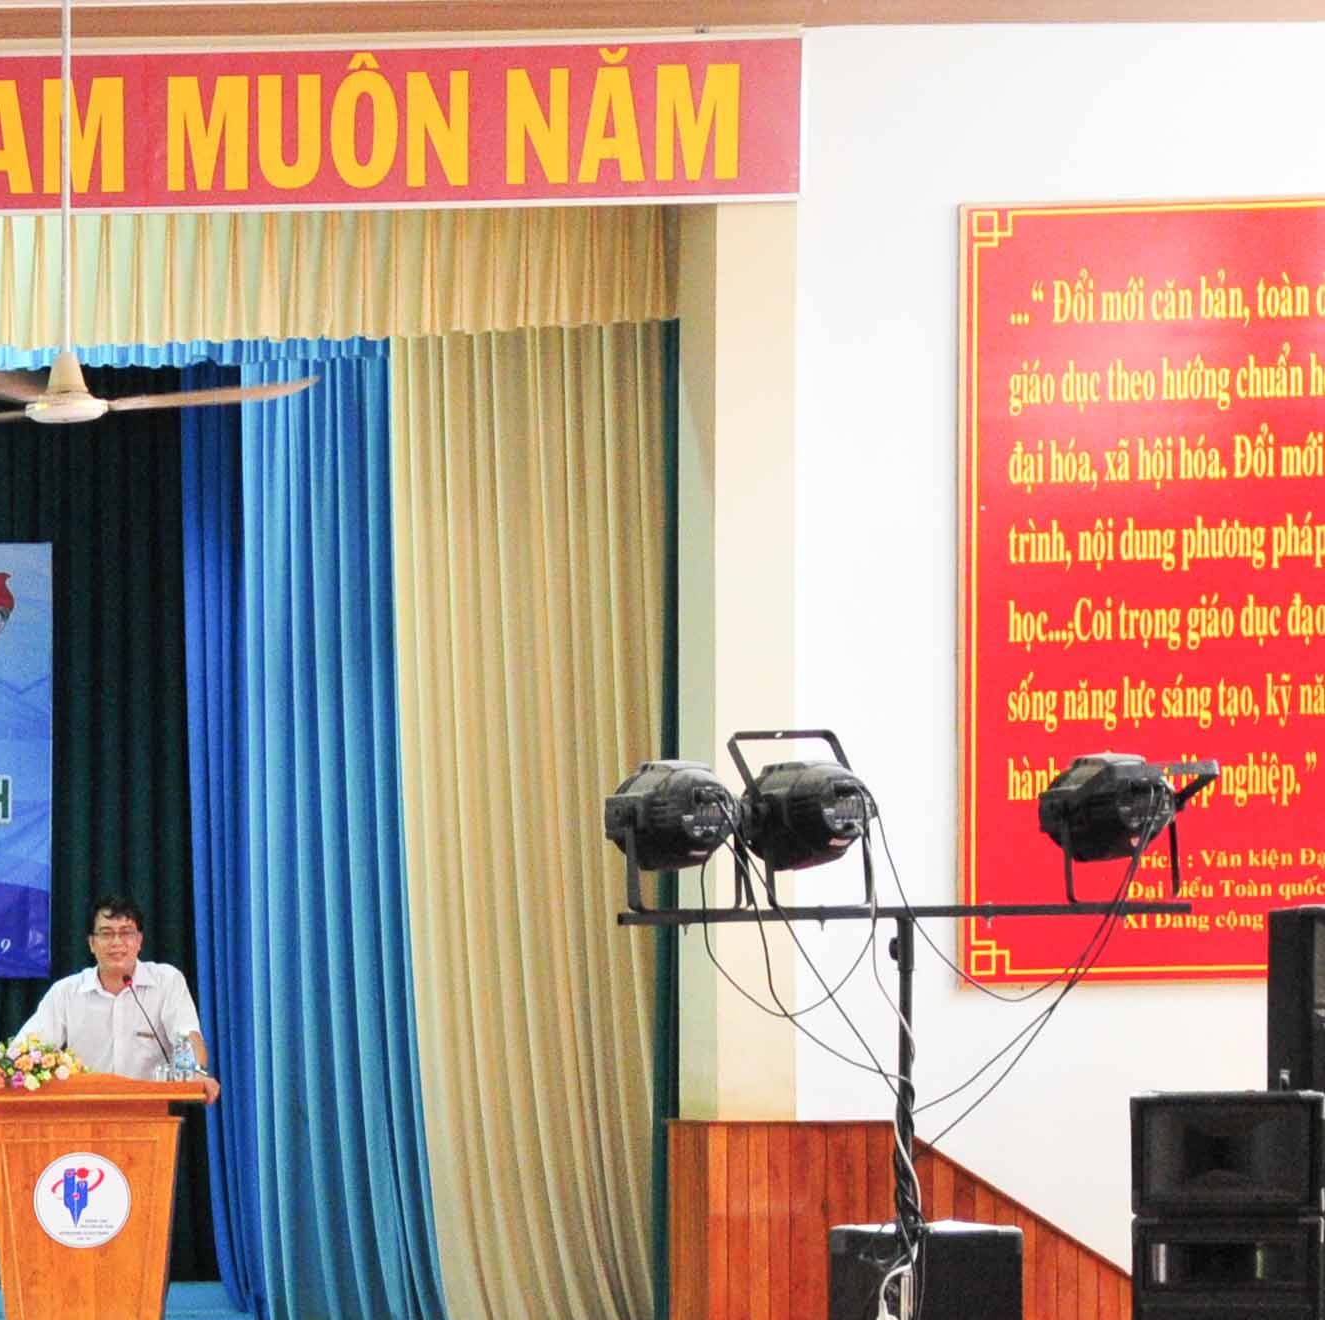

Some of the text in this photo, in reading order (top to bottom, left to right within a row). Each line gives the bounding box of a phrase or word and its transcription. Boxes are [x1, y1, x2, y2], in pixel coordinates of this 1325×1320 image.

[167, 52, 470, 192] MUÔN
[505, 47, 741, 186] NĂM
[1053, 267, 1095, 324] Đổi
[1100, 276, 1145, 322] mới
[1151, 278, 1193, 320] căn
[1200, 268, 1250, 327] bản,
[1257, 271, 1310, 318] toàn
[1009, 359, 1056, 416] giáo
[1060, 359, 1101, 413] dục
[1107, 357, 1156, 401] theo
[1161, 353, 1231, 411] hướng
[1236, 341, 1304, 399] chuẩn
[1008, 422, 1325, 494] đại hóa, xã hội hóa. Đổi mới
[1008, 517, 1072, 571] trình,
[1077, 516, 1114, 571] nội
[1120, 516, 1176, 571] dung
[1181, 514, 1266, 571] phương
[1118, 599, 1182, 650] trọng
[1186, 592, 1235, 650] giáo
[1240, 593, 1282, 647] dục
[1007, 671, 1058, 732] sống
[1063, 679, 1118, 731] năng
[1122, 675, 1156, 728] lực
[1161, 673, 1213, 729] sáng
[1218, 677, 1261, 728] tạo,
[1220, 751, 1302, 808] nghiệp.
[1174, 875, 1214, 899] iểu
[1218, 876, 1273, 898] Toàn
[1199, 847, 1242, 869] Văn
[1248, 847, 1294, 871] kiện
[1215, 909, 1265, 931] cộng
